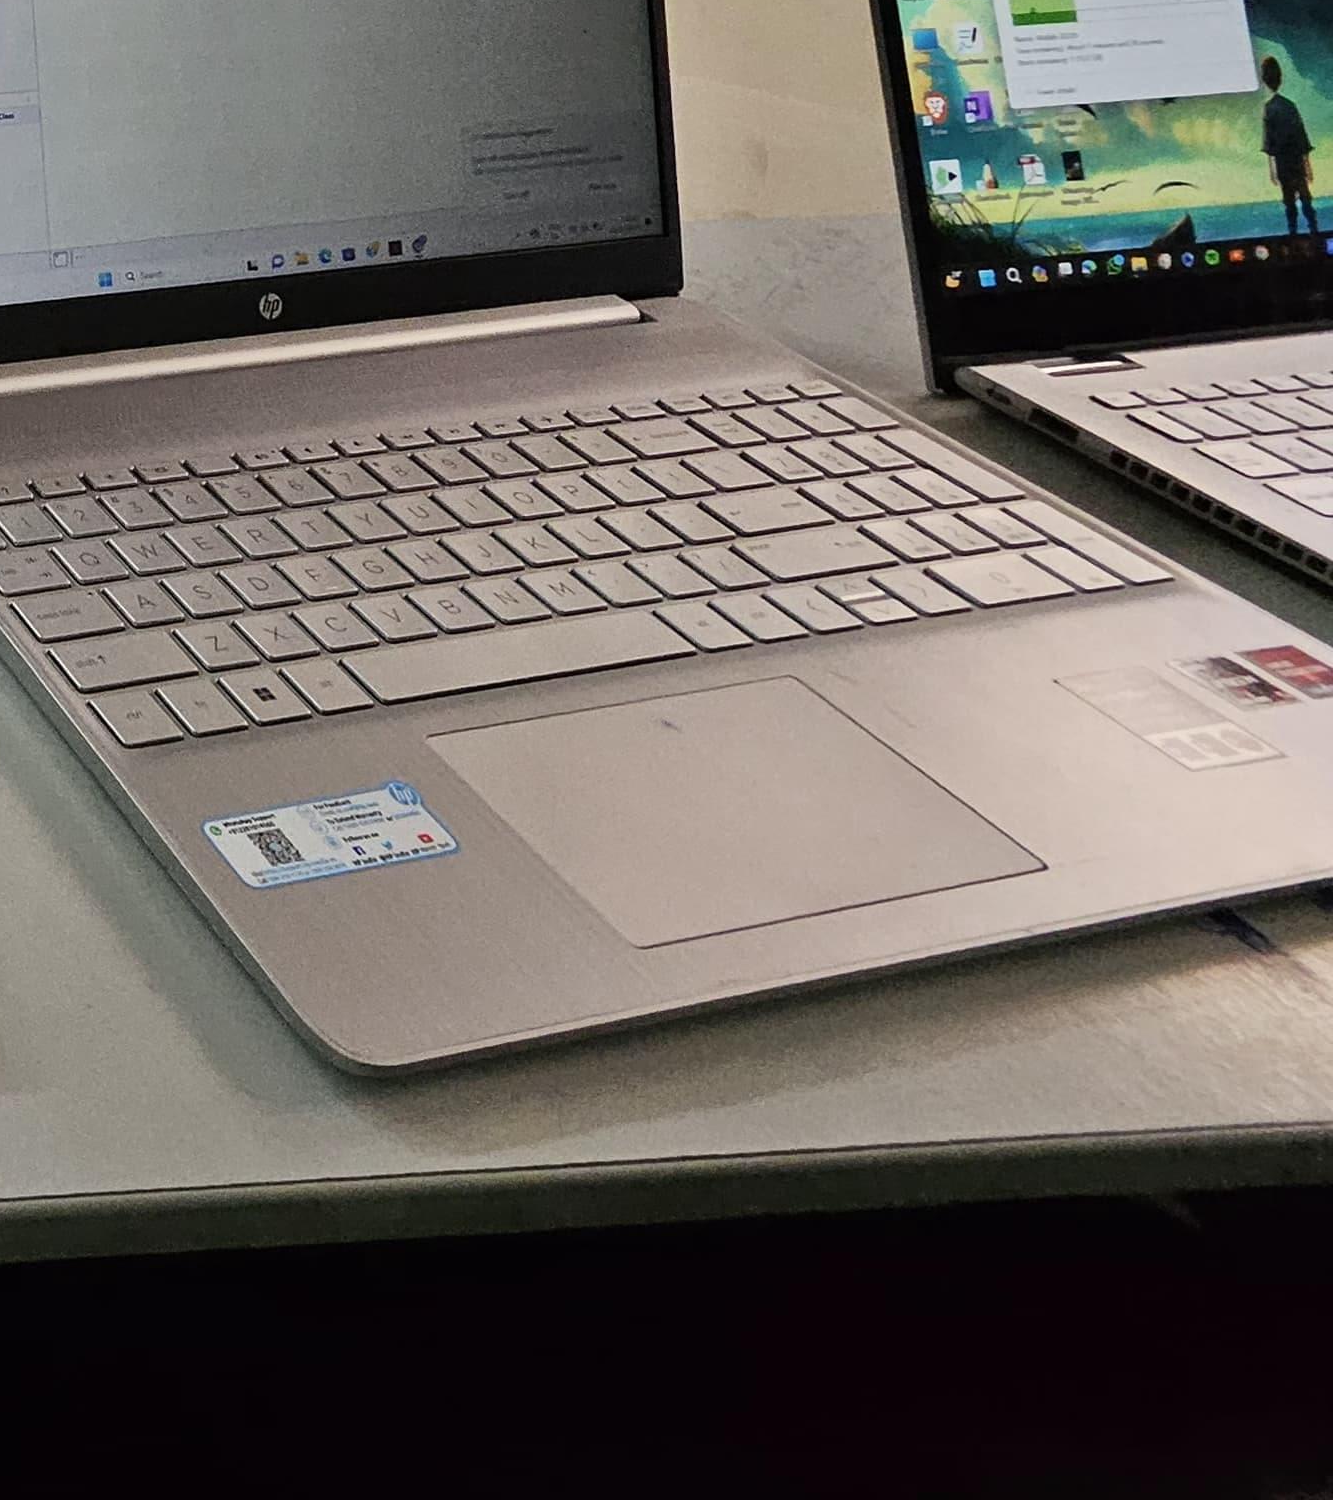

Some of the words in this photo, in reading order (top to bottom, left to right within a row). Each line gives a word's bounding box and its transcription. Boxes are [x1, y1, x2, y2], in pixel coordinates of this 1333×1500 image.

[407, 506, 430, 520] U
[191, 536, 214, 550] E
[247, 529, 267, 543] R
[131, 543, 159, 560] W
[247, 576, 269, 592] D
[547, 582, 575, 598] M
[191, 585, 212, 600] S
[136, 593, 155, 609] A
[437, 599, 461, 615] B
[264, 625, 289, 641] X
[325, 618, 348, 633] C
[204, 635, 228, 652] Z
